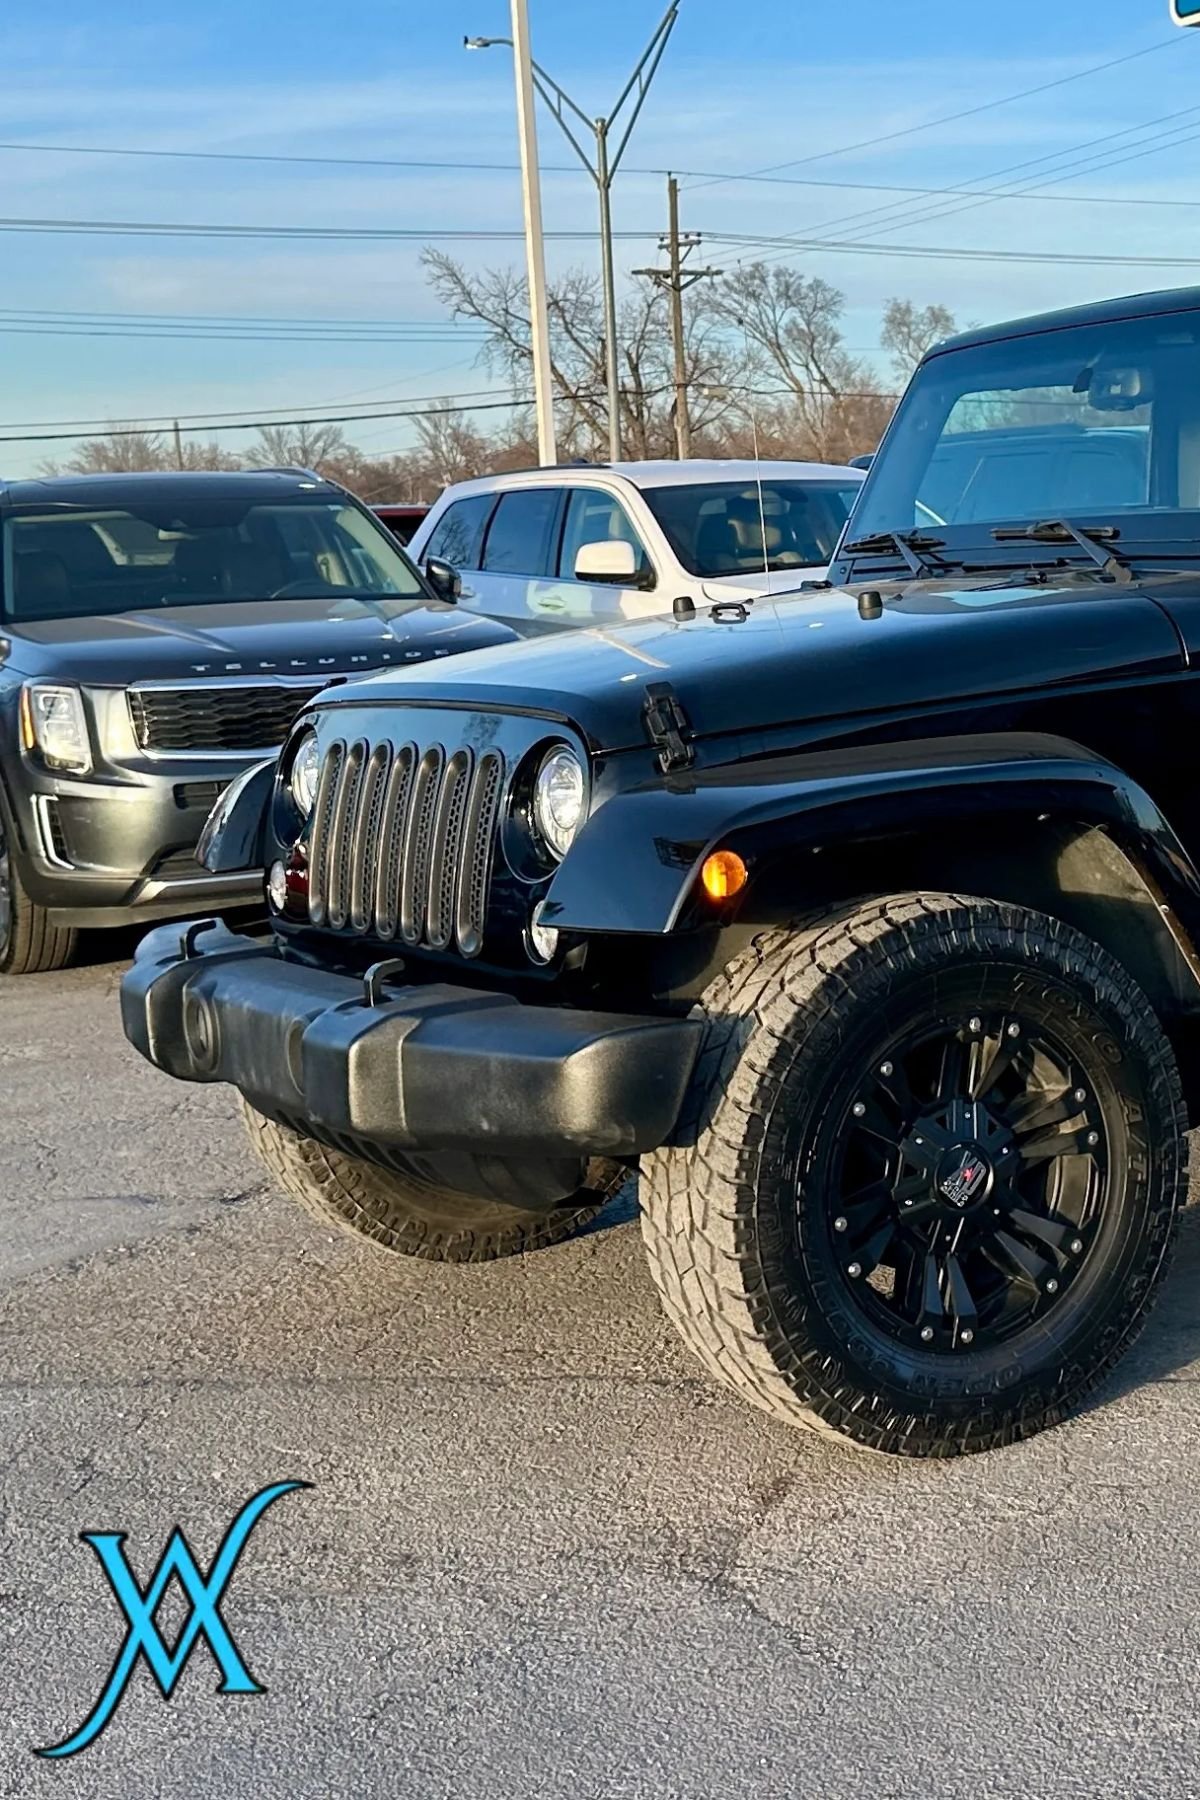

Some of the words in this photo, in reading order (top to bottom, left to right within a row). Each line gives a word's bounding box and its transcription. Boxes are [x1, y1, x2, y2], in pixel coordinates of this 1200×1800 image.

[191, 649, 450, 671] TELLURIDE
[1012, 971, 1124, 1067] TOYO
[945, 1150, 987, 1196] XD
